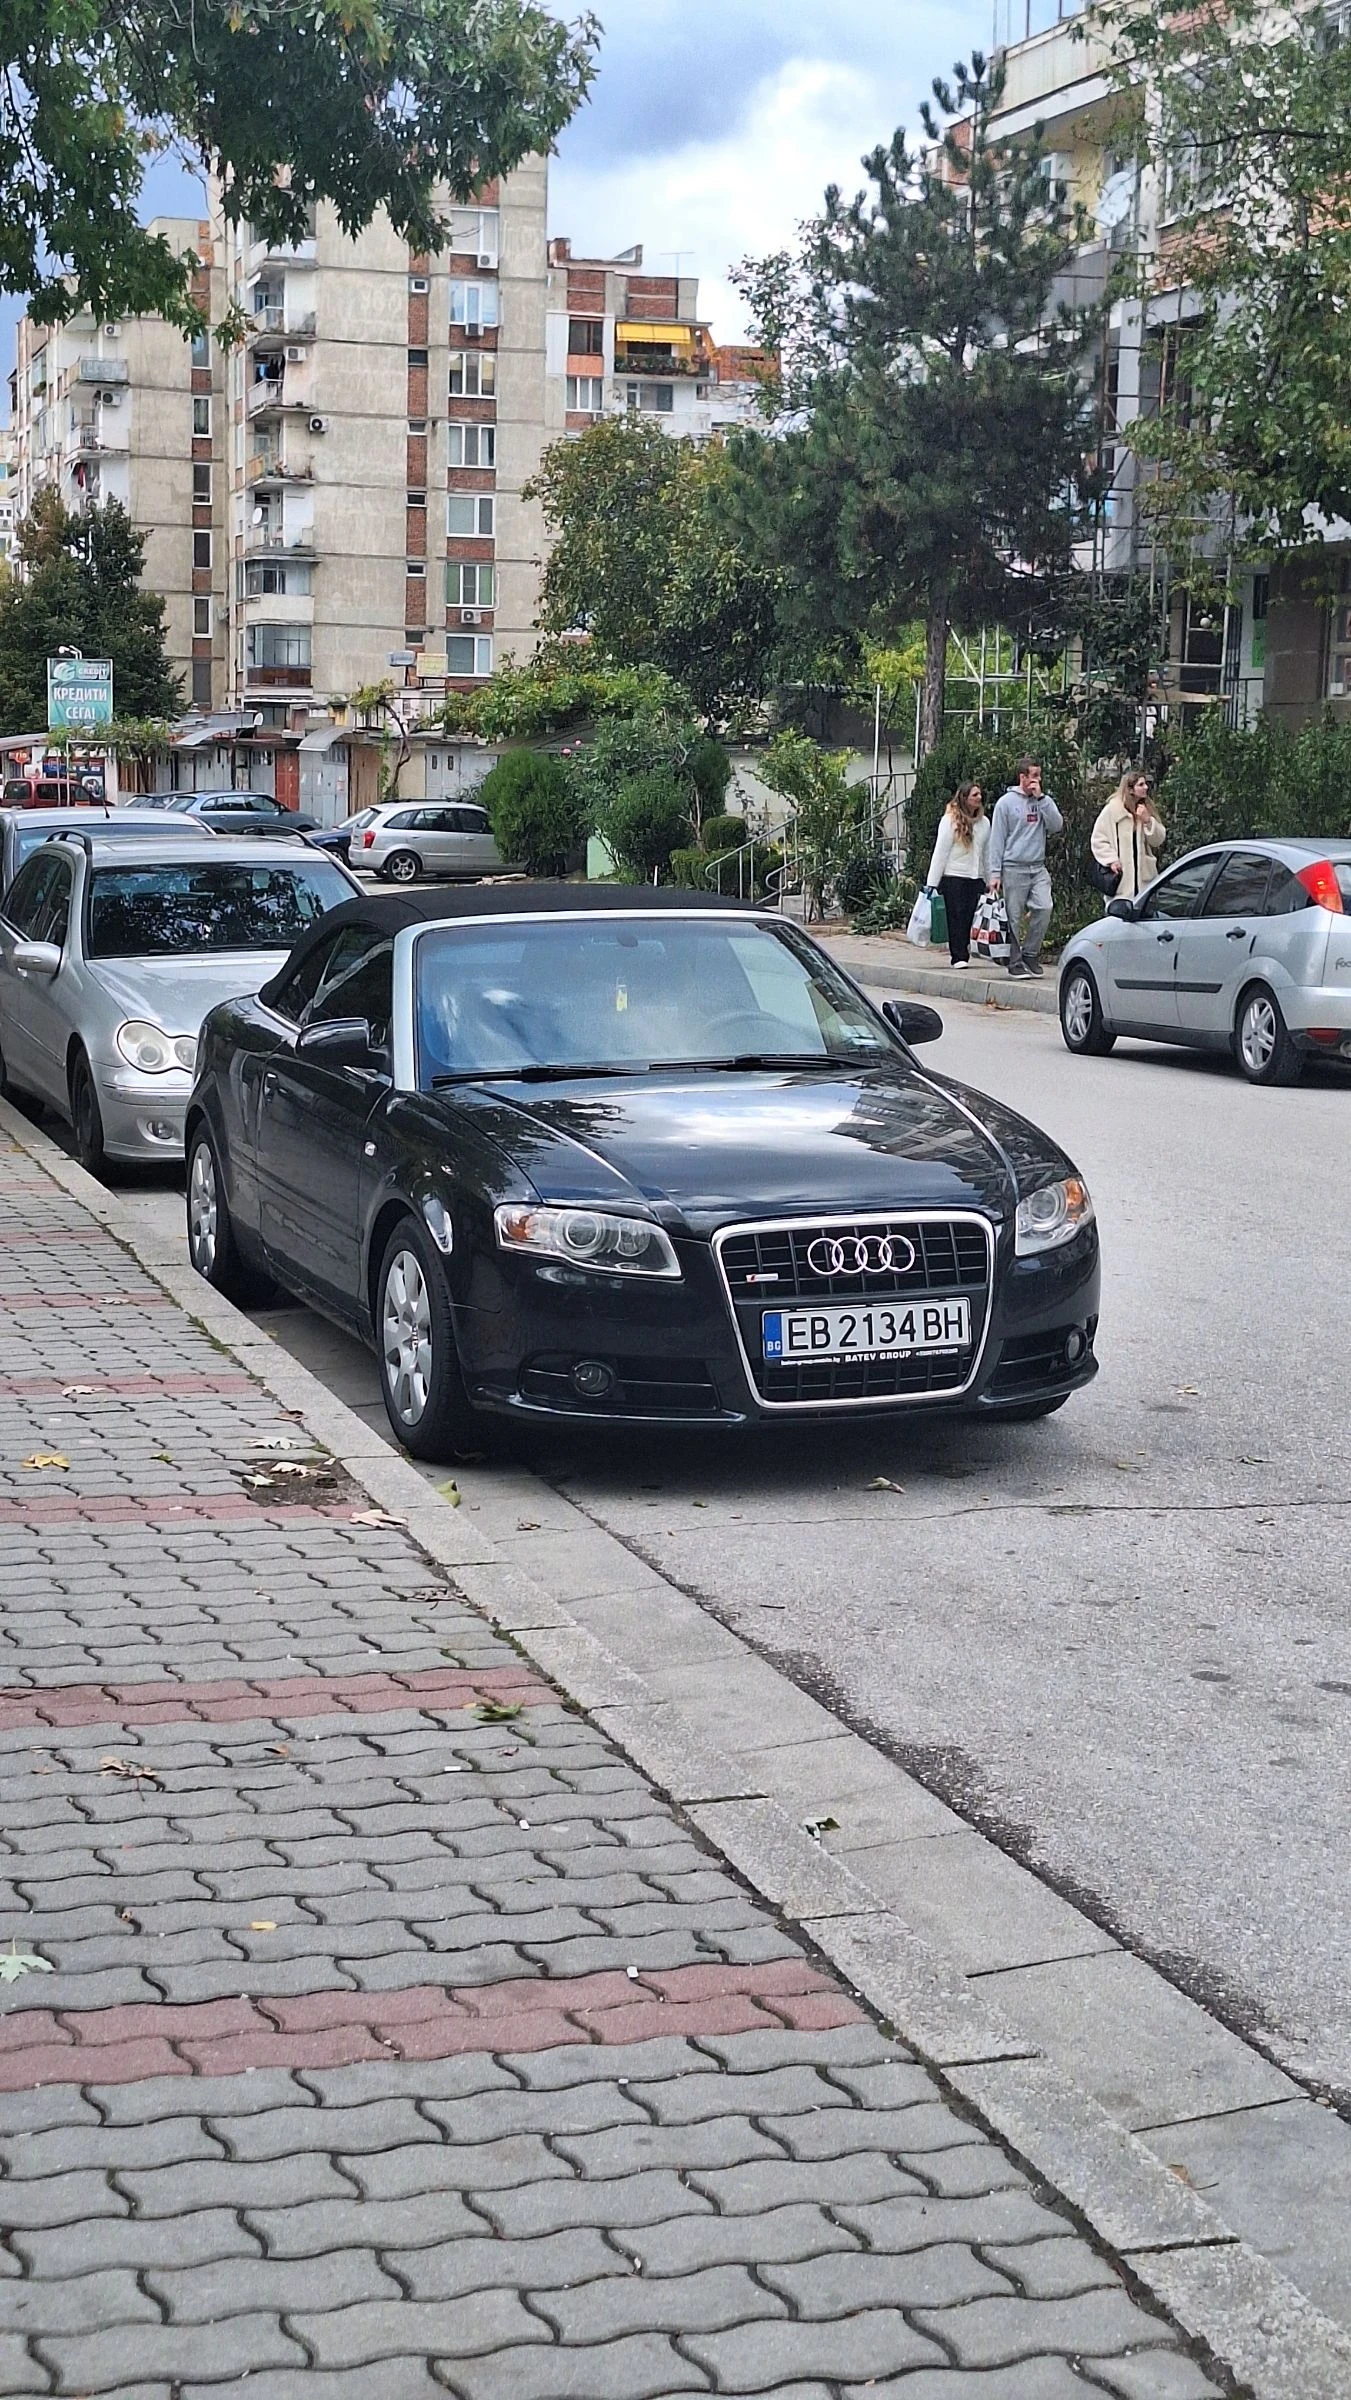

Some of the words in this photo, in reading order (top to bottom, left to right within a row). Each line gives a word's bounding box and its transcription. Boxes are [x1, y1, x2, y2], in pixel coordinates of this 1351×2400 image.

[54, 688, 106, 702] КРЕДИТИ
[66, 707, 95, 719] СЕГА!
[788, 1316, 830, 1350] EB
[838, 1310, 916, 1347] 2134
[923, 1306, 963, 1340] BH
[767, 1341, 781, 1351] BG
[844, 1353, 876, 1362] BATEV
[880, 1350, 911, 1360] GROUP
